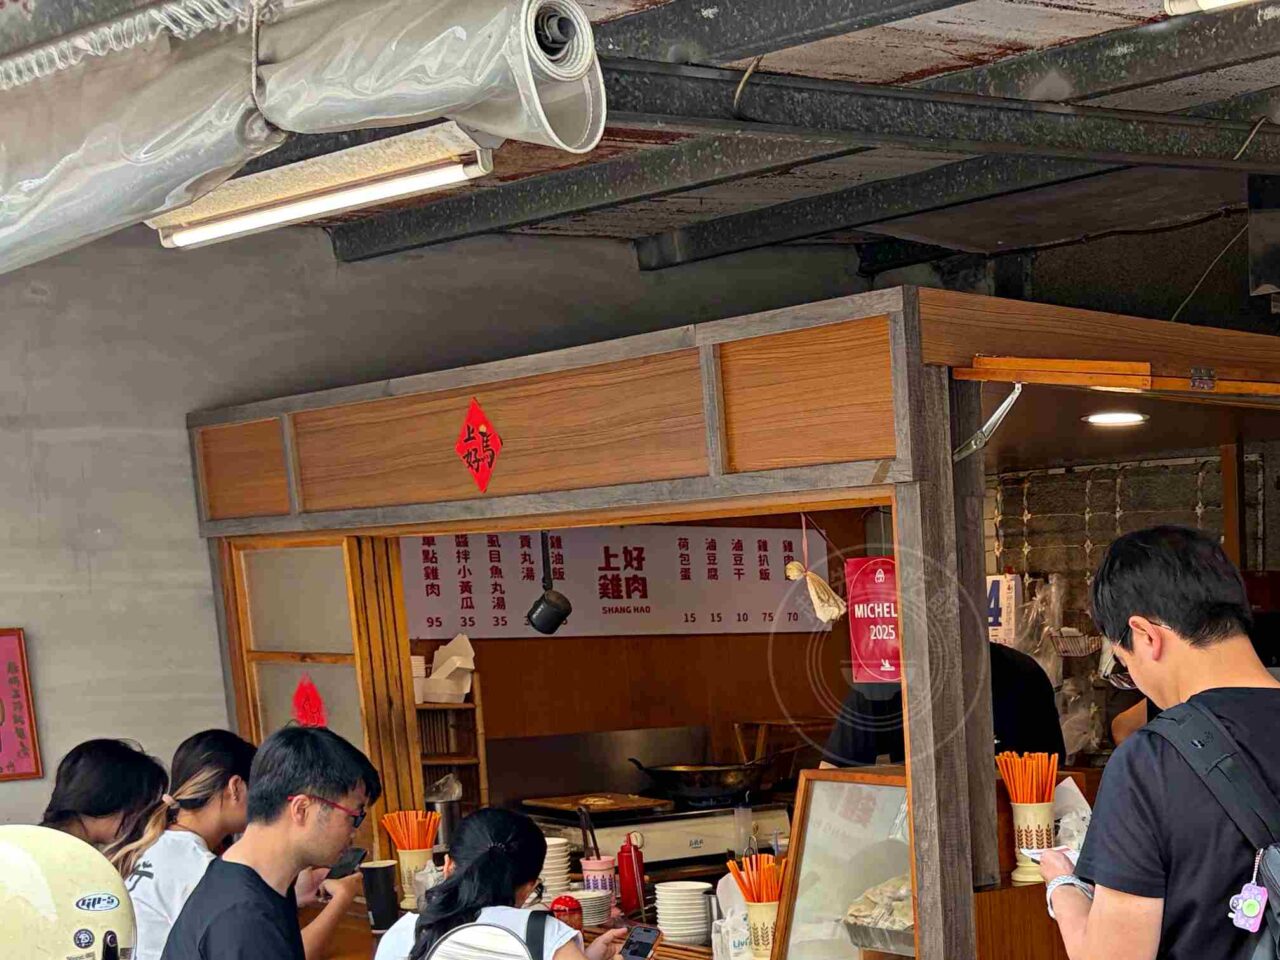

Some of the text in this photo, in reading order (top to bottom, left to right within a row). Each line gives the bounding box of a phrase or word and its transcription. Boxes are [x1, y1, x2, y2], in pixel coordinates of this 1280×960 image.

[519, 535, 535, 581] 貢丸湯
[549, 535, 565, 581] 雞油飯
[598, 546, 645, 571] 上好
[598, 574, 648, 599] 雞肉
[678, 538, 696, 622] 荷包蛋 15
[705, 538, 722, 622] 滷豆腐 15
[731, 538, 749, 622] 滷豆干 10
[757, 539, 774, 622] 雞扒飯 75
[426, 616, 443, 628] 95
[460, 616, 476, 627] 35
[492, 616, 508, 627] 35
[602, 606, 651, 614] SHANG HAO
[787, 612, 799, 622] 70
[870, 625, 896, 640] 2025
